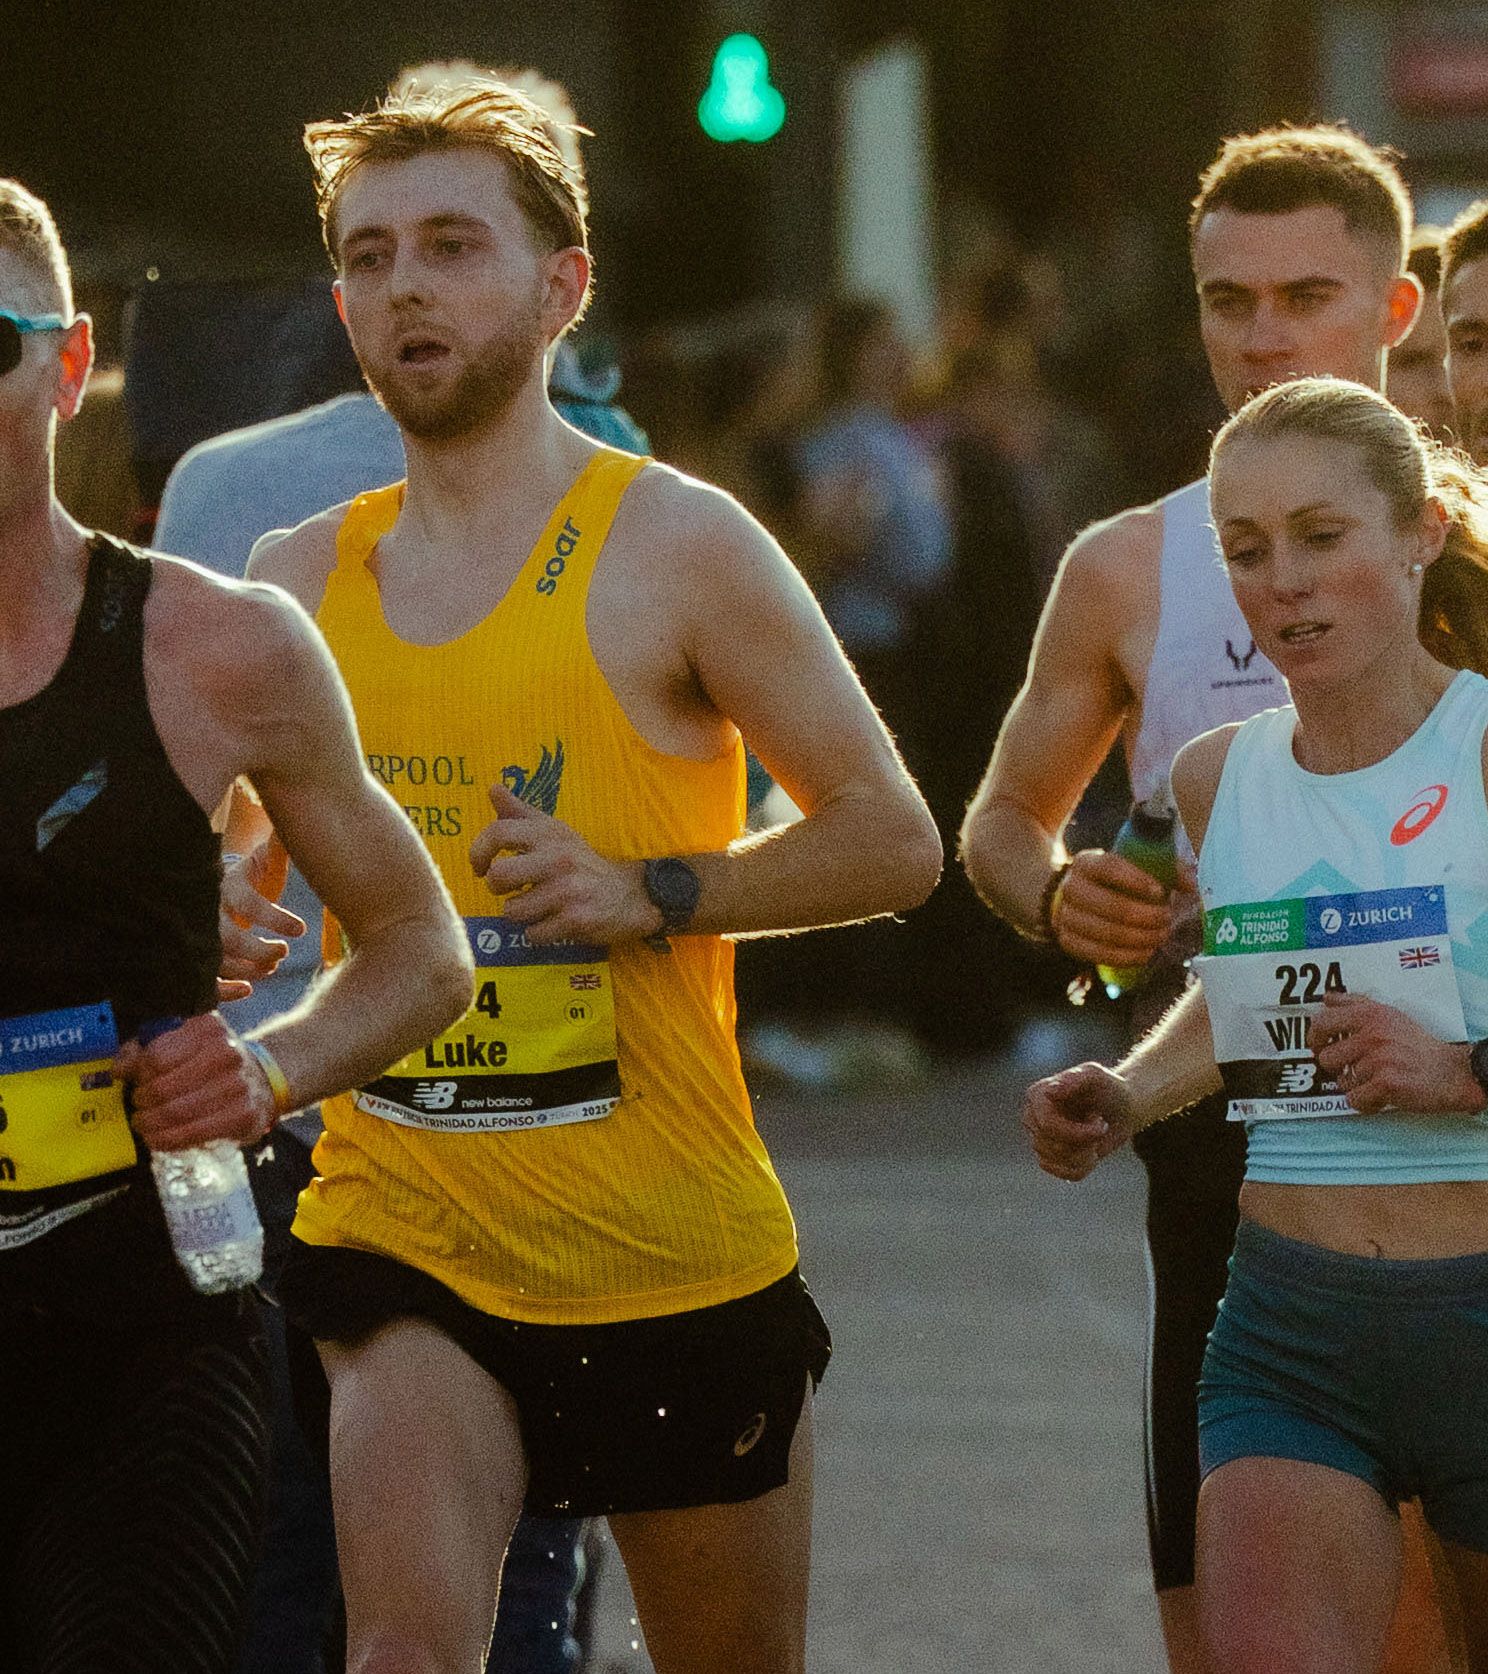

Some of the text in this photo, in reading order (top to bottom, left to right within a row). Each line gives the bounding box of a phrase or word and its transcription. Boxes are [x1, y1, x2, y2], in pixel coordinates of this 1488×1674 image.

[536, 516, 581, 596] soar
[1348, 905, 1413, 927] ZURICH
[1240, 919, 1289, 933] TRINIDAD
[1239, 931, 1289, 946] ALFONSO
[1275, 961, 1347, 1006] 224
[569, 1007, 586, 1020] 01
[10, 1028, 82, 1054] ZURICH
[424, 1034, 508, 1069] Luke
[461, 1098, 485, 1108] new
[486, 1096, 533, 1107] balance
[1286, 1101, 1334, 1114] TRINIDAD
[82, 1109, 96, 1124] 01
[424, 1117, 475, 1129] TRINIDAD
[477, 1115, 534, 1128] ALFONSO
[582, 1104, 608, 1117] 2025
